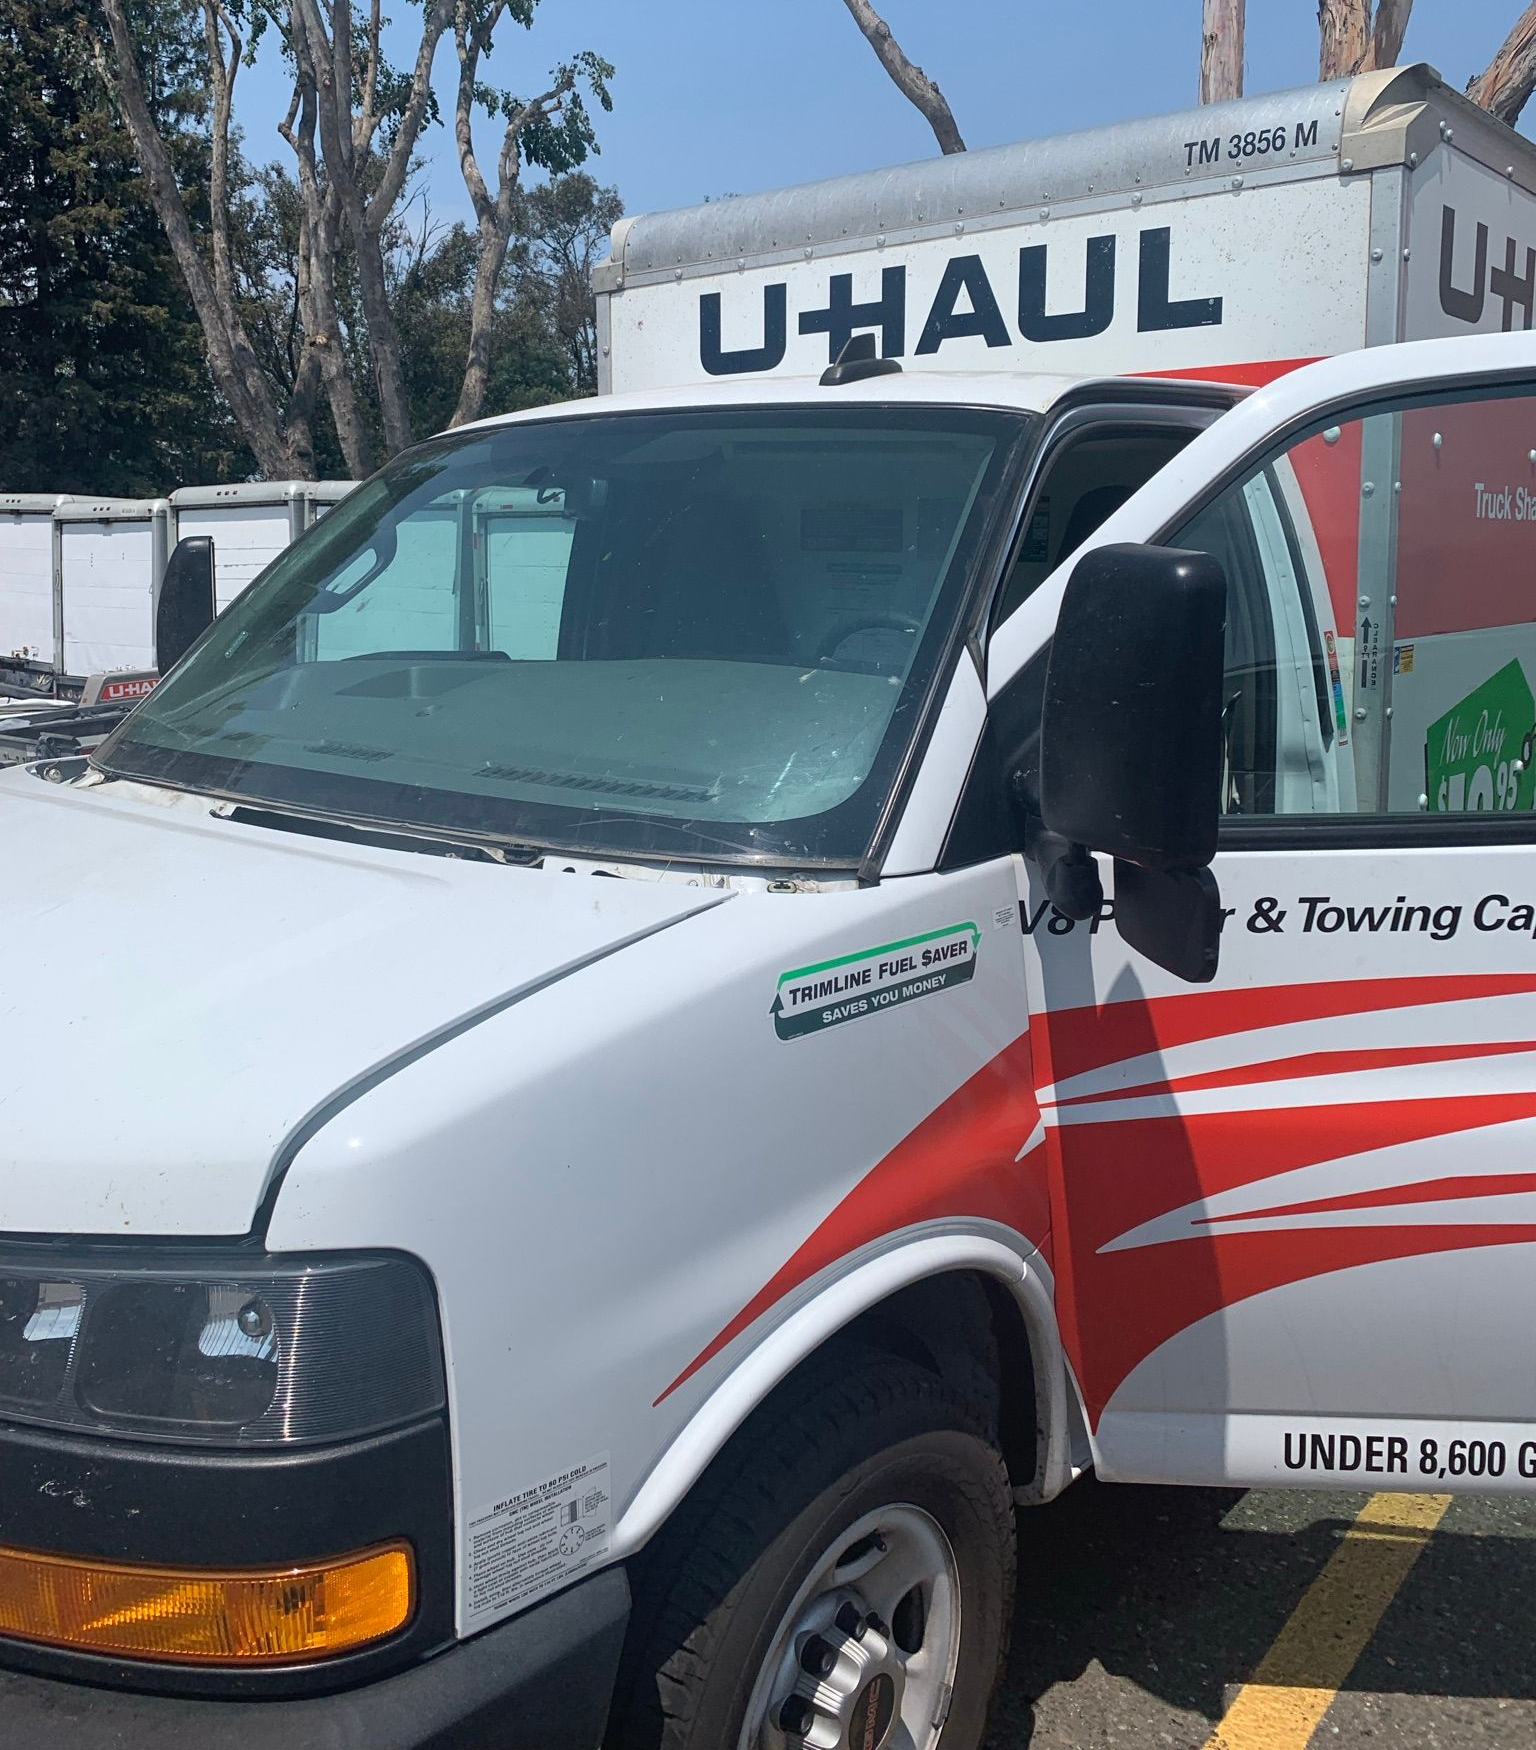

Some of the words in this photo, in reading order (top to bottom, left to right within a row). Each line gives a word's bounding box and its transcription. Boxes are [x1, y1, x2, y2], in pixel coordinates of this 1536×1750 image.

[1183, 137, 1221, 166] TM
[1228, 126, 1286, 159] 3856
[1294, 120, 1319, 148] M
[1475, 482, 1512, 520] Truck
[109, 681, 157, 697] U-HA
[1439, 716, 1471, 767] Now
[1473, 710, 1506, 770] Only
[1246, 896, 1288, 934] &
[1297, 896, 1462, 941] Towing
[1473, 894, 1536, 939] Ca
[788, 968, 871, 1006] TRIMLINE
[878, 955, 917, 980] FUEL
[822, 999, 868, 1024] SAVES
[870, 989, 900, 1008] YOU
[902, 973, 947, 998] MONEY
[1284, 1432, 1408, 1473] UNDER
[1419, 1438, 1506, 1479] 8,600
[494, 1495, 520, 1512] INFLATE
[523, 1488, 536, 1499] TIRE
[539, 1483, 547, 1492] TO
[558, 1474, 568, 1484] PSI
[571, 1466, 586, 1478] COLD
